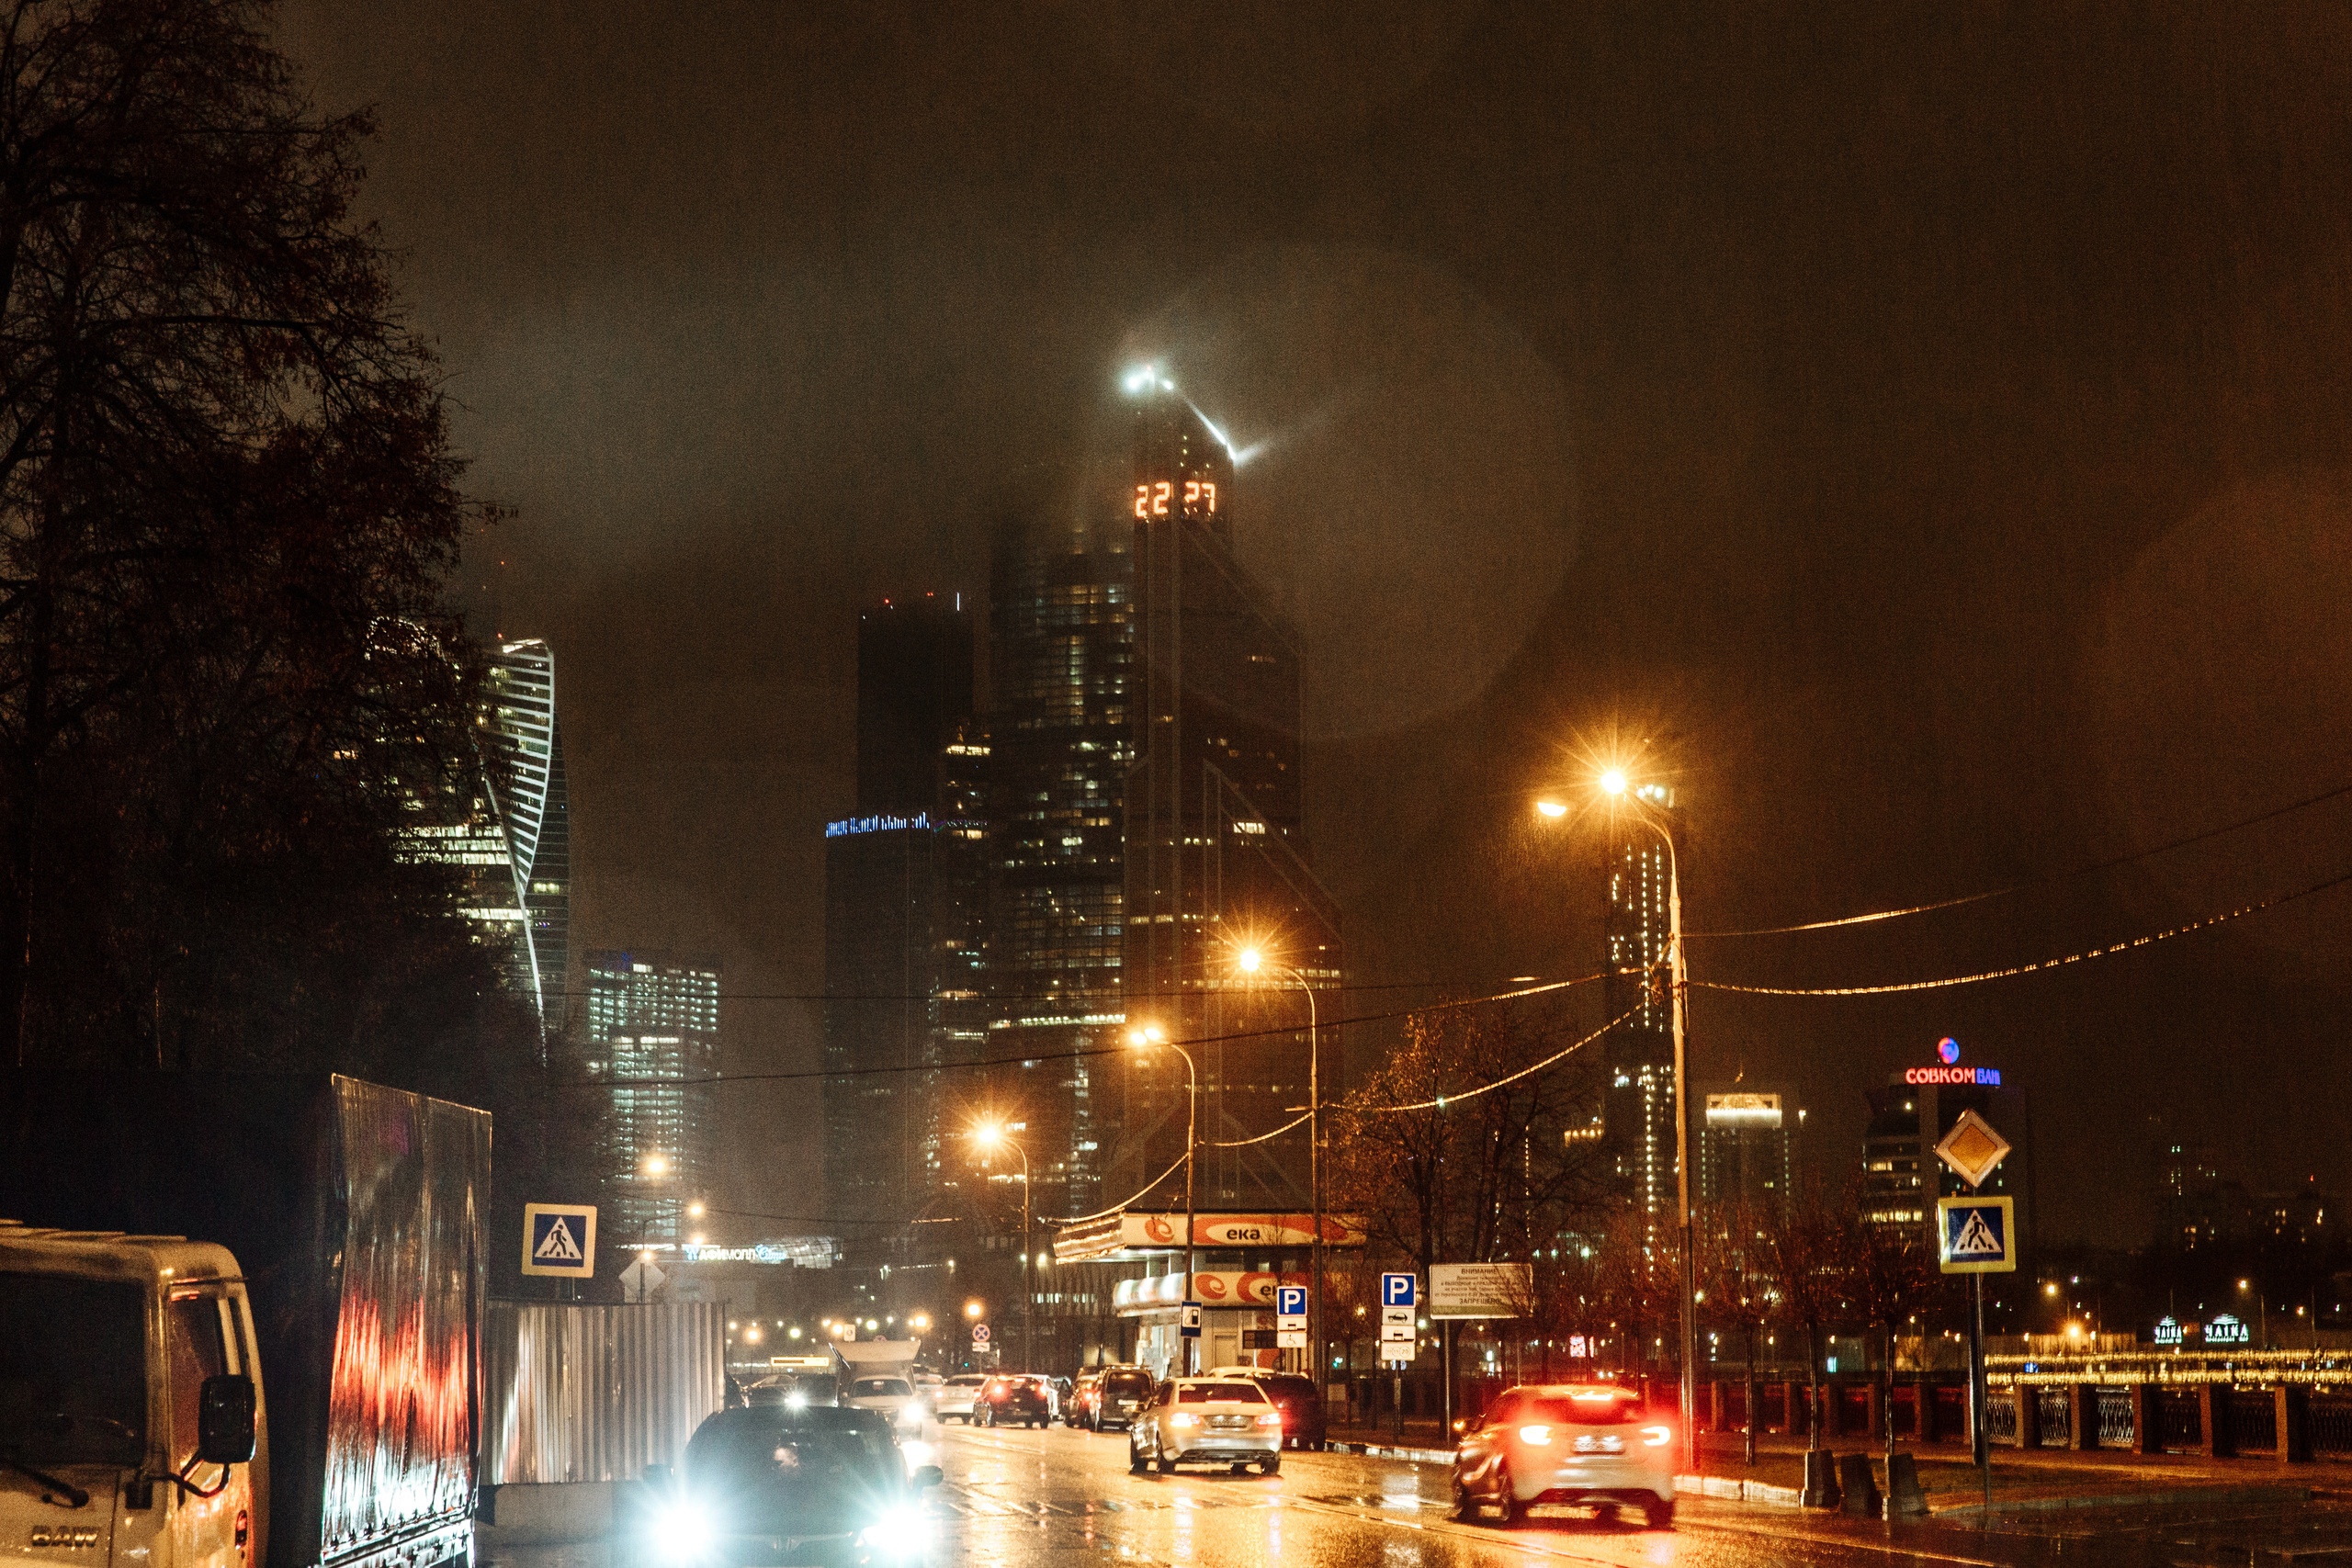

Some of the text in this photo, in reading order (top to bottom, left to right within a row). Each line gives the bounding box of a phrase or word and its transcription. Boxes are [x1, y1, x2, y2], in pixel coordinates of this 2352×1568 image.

[1135, 480, 1170, 517] 22
[1283, 1289, 1302, 1314] P
[1389, 1276, 1409, 1304] P
[32, 1526, 101, 1548] BAW
